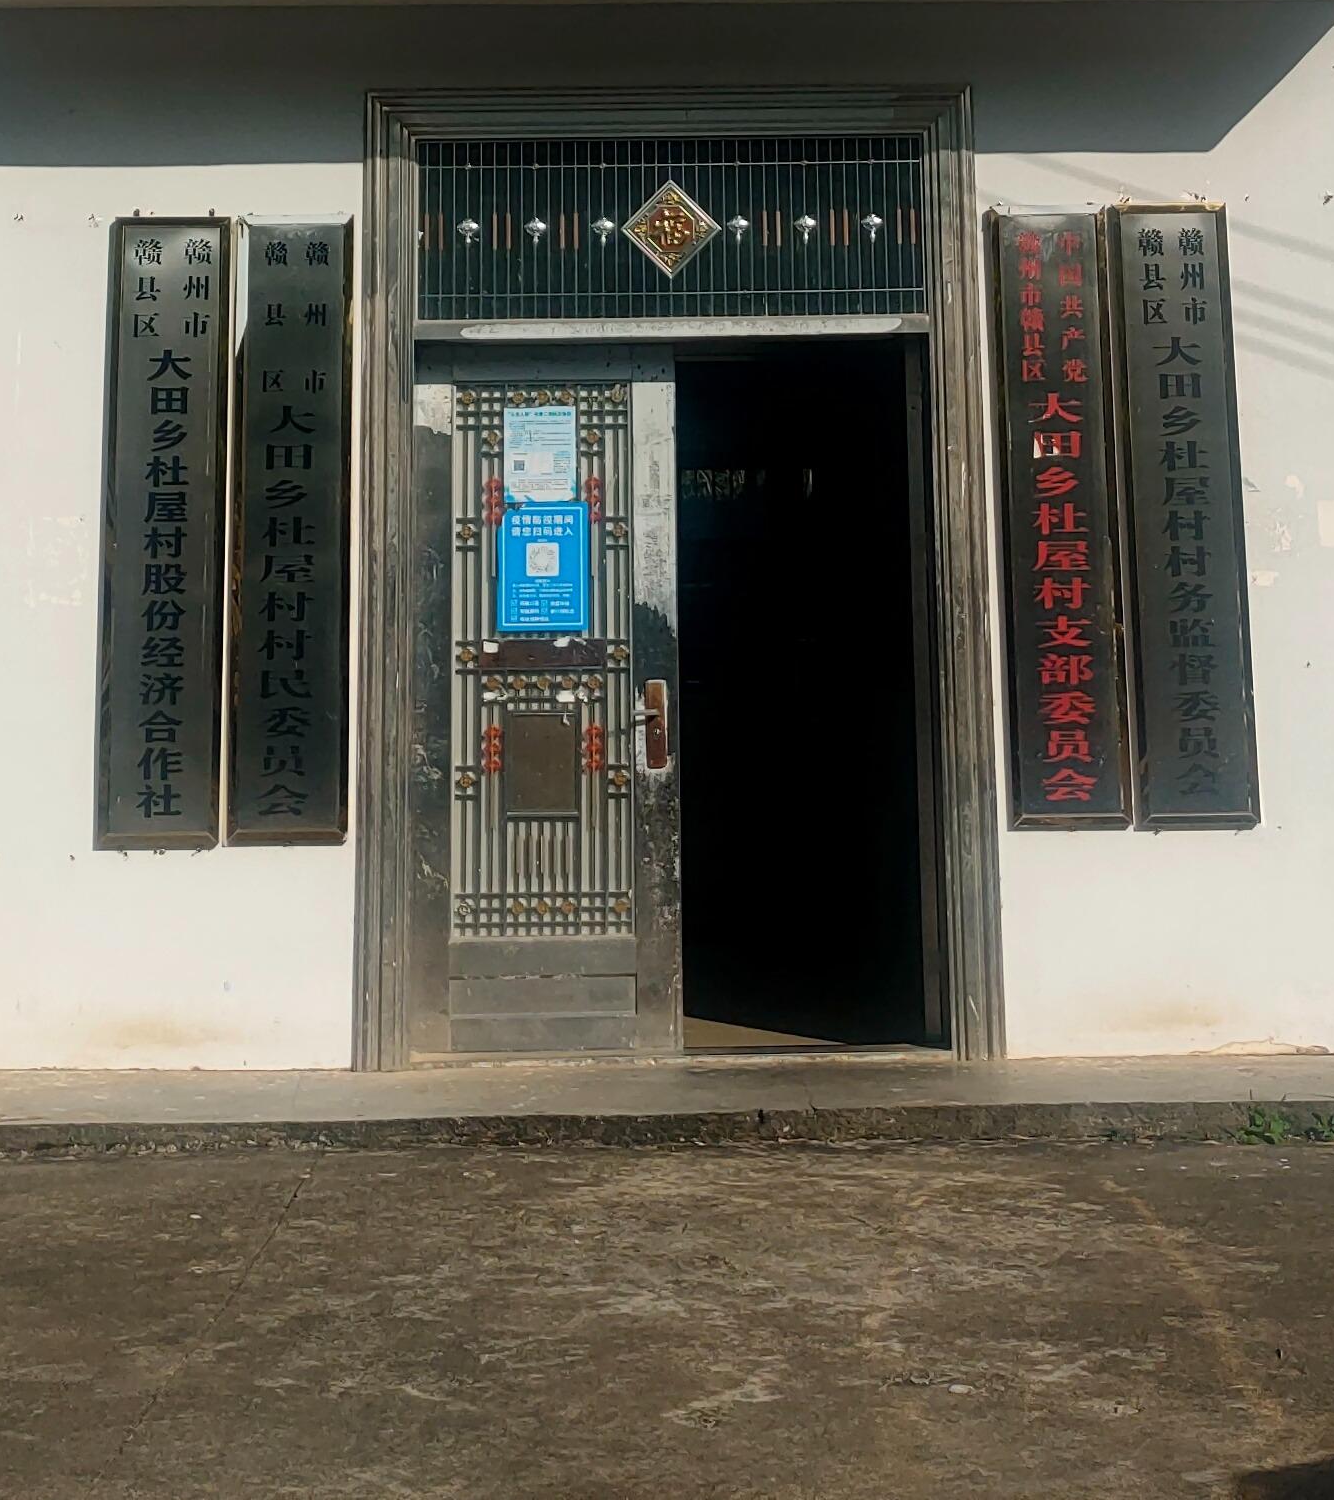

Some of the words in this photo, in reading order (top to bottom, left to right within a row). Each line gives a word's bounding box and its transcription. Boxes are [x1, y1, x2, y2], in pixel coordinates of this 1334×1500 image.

[133, 239, 163, 338] 赣县区
[183, 239, 212, 338] 赣州市
[262, 241, 288, 392] 赣县区
[304, 241, 330, 394] 赣州市
[1057, 231, 1089, 382] 中国共产党
[1137, 228, 1168, 325] 赣县区
[1178, 228, 1207, 325] 赣州市
[136, 349, 192, 818] 大田乡杜屋村股份经济合作社
[257, 406, 316, 816] 大田乡杜屋村村民委员会
[1028, 393, 1098, 801] 大田乡杜屋村支部委员会
[1152, 337, 1220, 796] 大田乡杜屋村村务监督委员会
